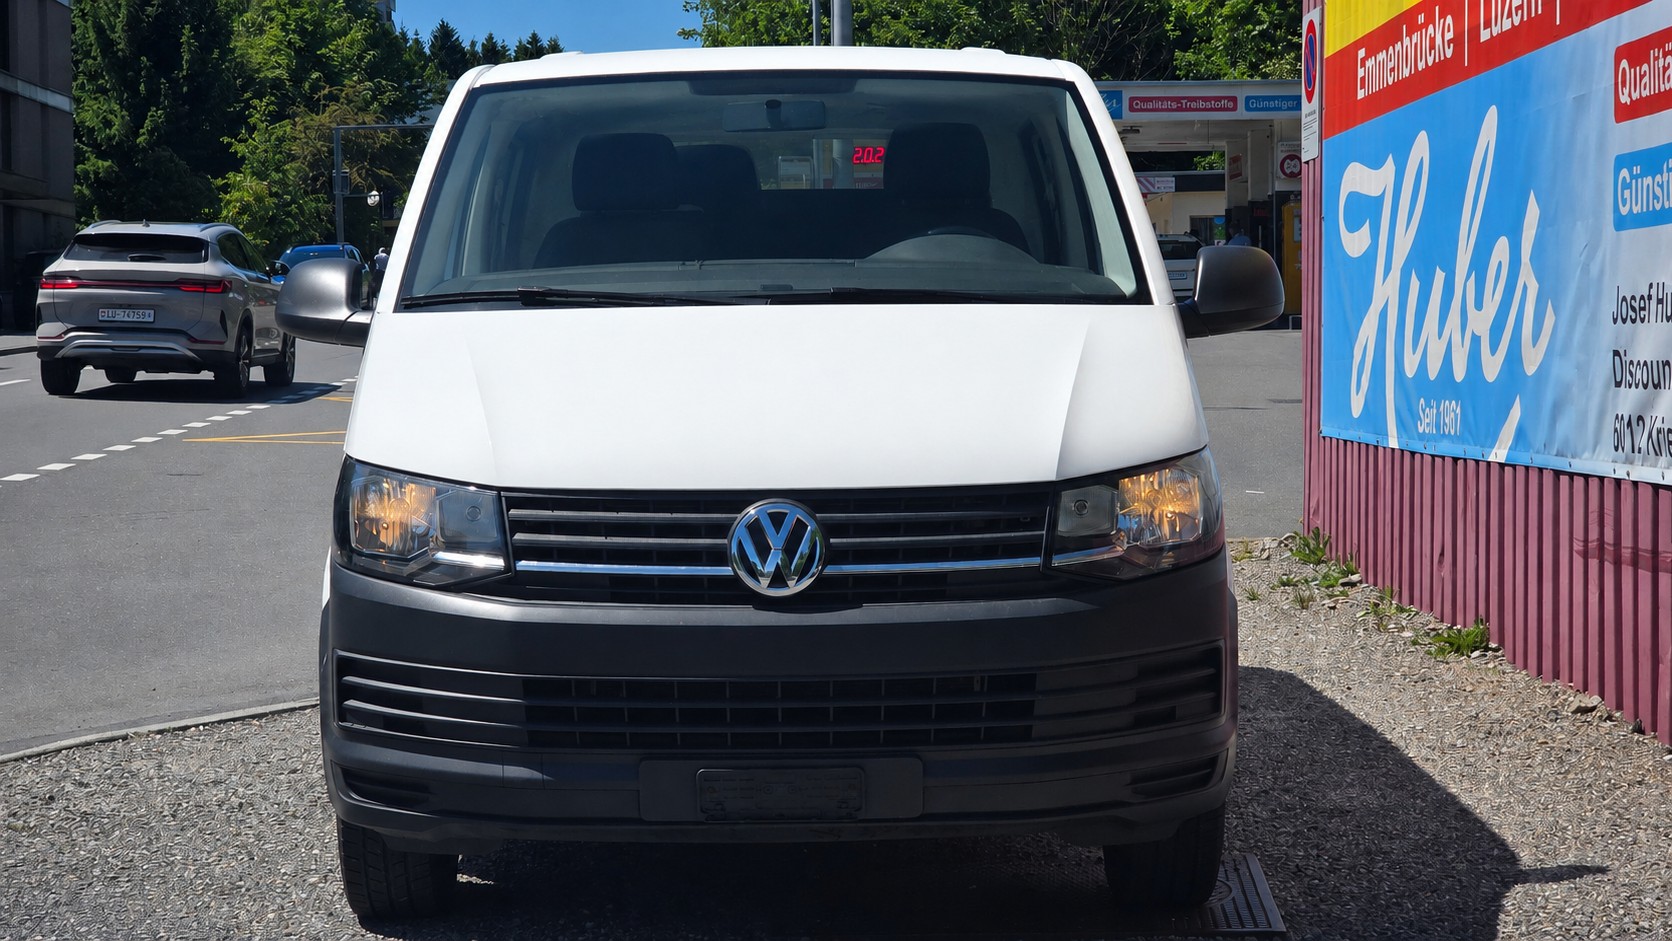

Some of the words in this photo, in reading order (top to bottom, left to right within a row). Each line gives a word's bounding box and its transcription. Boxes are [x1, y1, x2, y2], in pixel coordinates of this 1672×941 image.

[1357, 5, 1454, 100] Emmenbrücke
[1133, 99, 1234, 109] Qualitäts-Treibstoffe
[1249, 98, 1298, 109] Günstiger
[1338, 104, 1556, 449] Huber
[1612, 282, 1653, 325] Josef
[1612, 349, 1672, 390] Discoun
[1417, 398, 1437, 434] Seit
[1440, 400, 1462, 436] 1961
[1613, 413, 1646, 454] 6012
